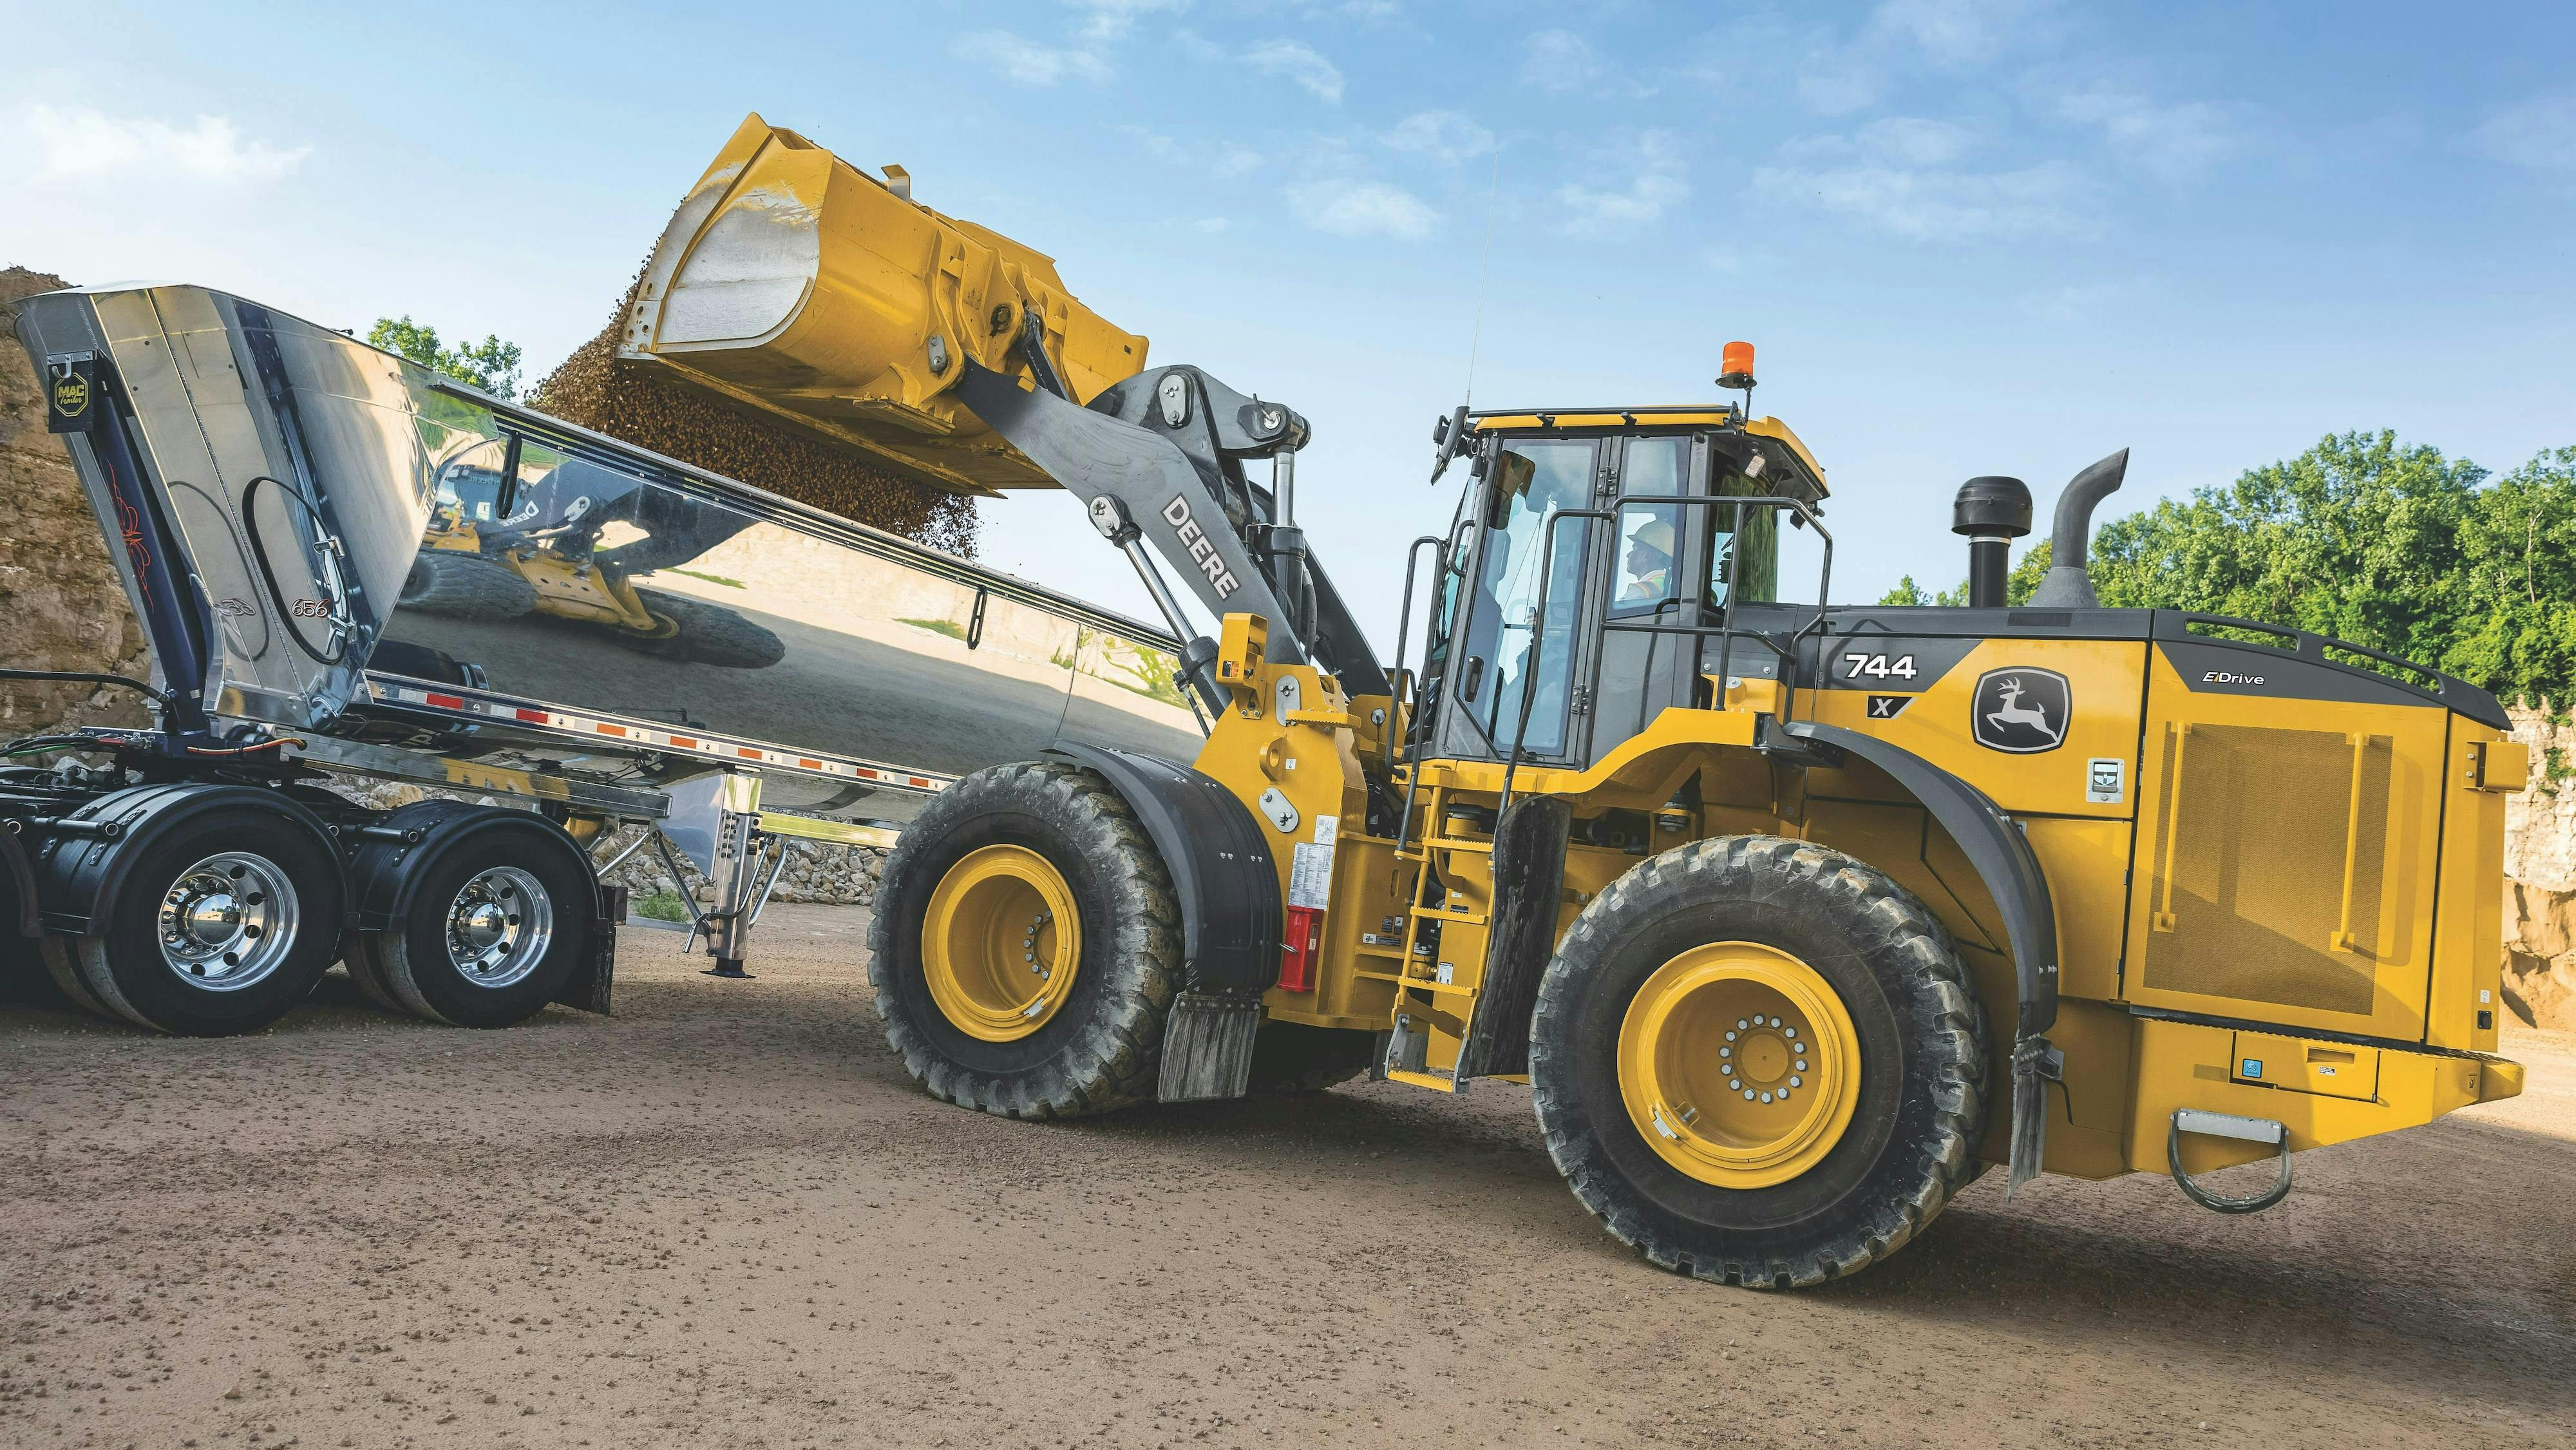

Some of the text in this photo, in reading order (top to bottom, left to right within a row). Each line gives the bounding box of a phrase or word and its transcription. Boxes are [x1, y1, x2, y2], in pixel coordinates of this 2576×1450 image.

[58, 385, 85, 397] MAC
[1162, 494, 1240, 600] DEERE
[292, 598, 330, 618] 656
[1845, 653, 1917, 680] 744
[1871, 698, 1894, 716] X
